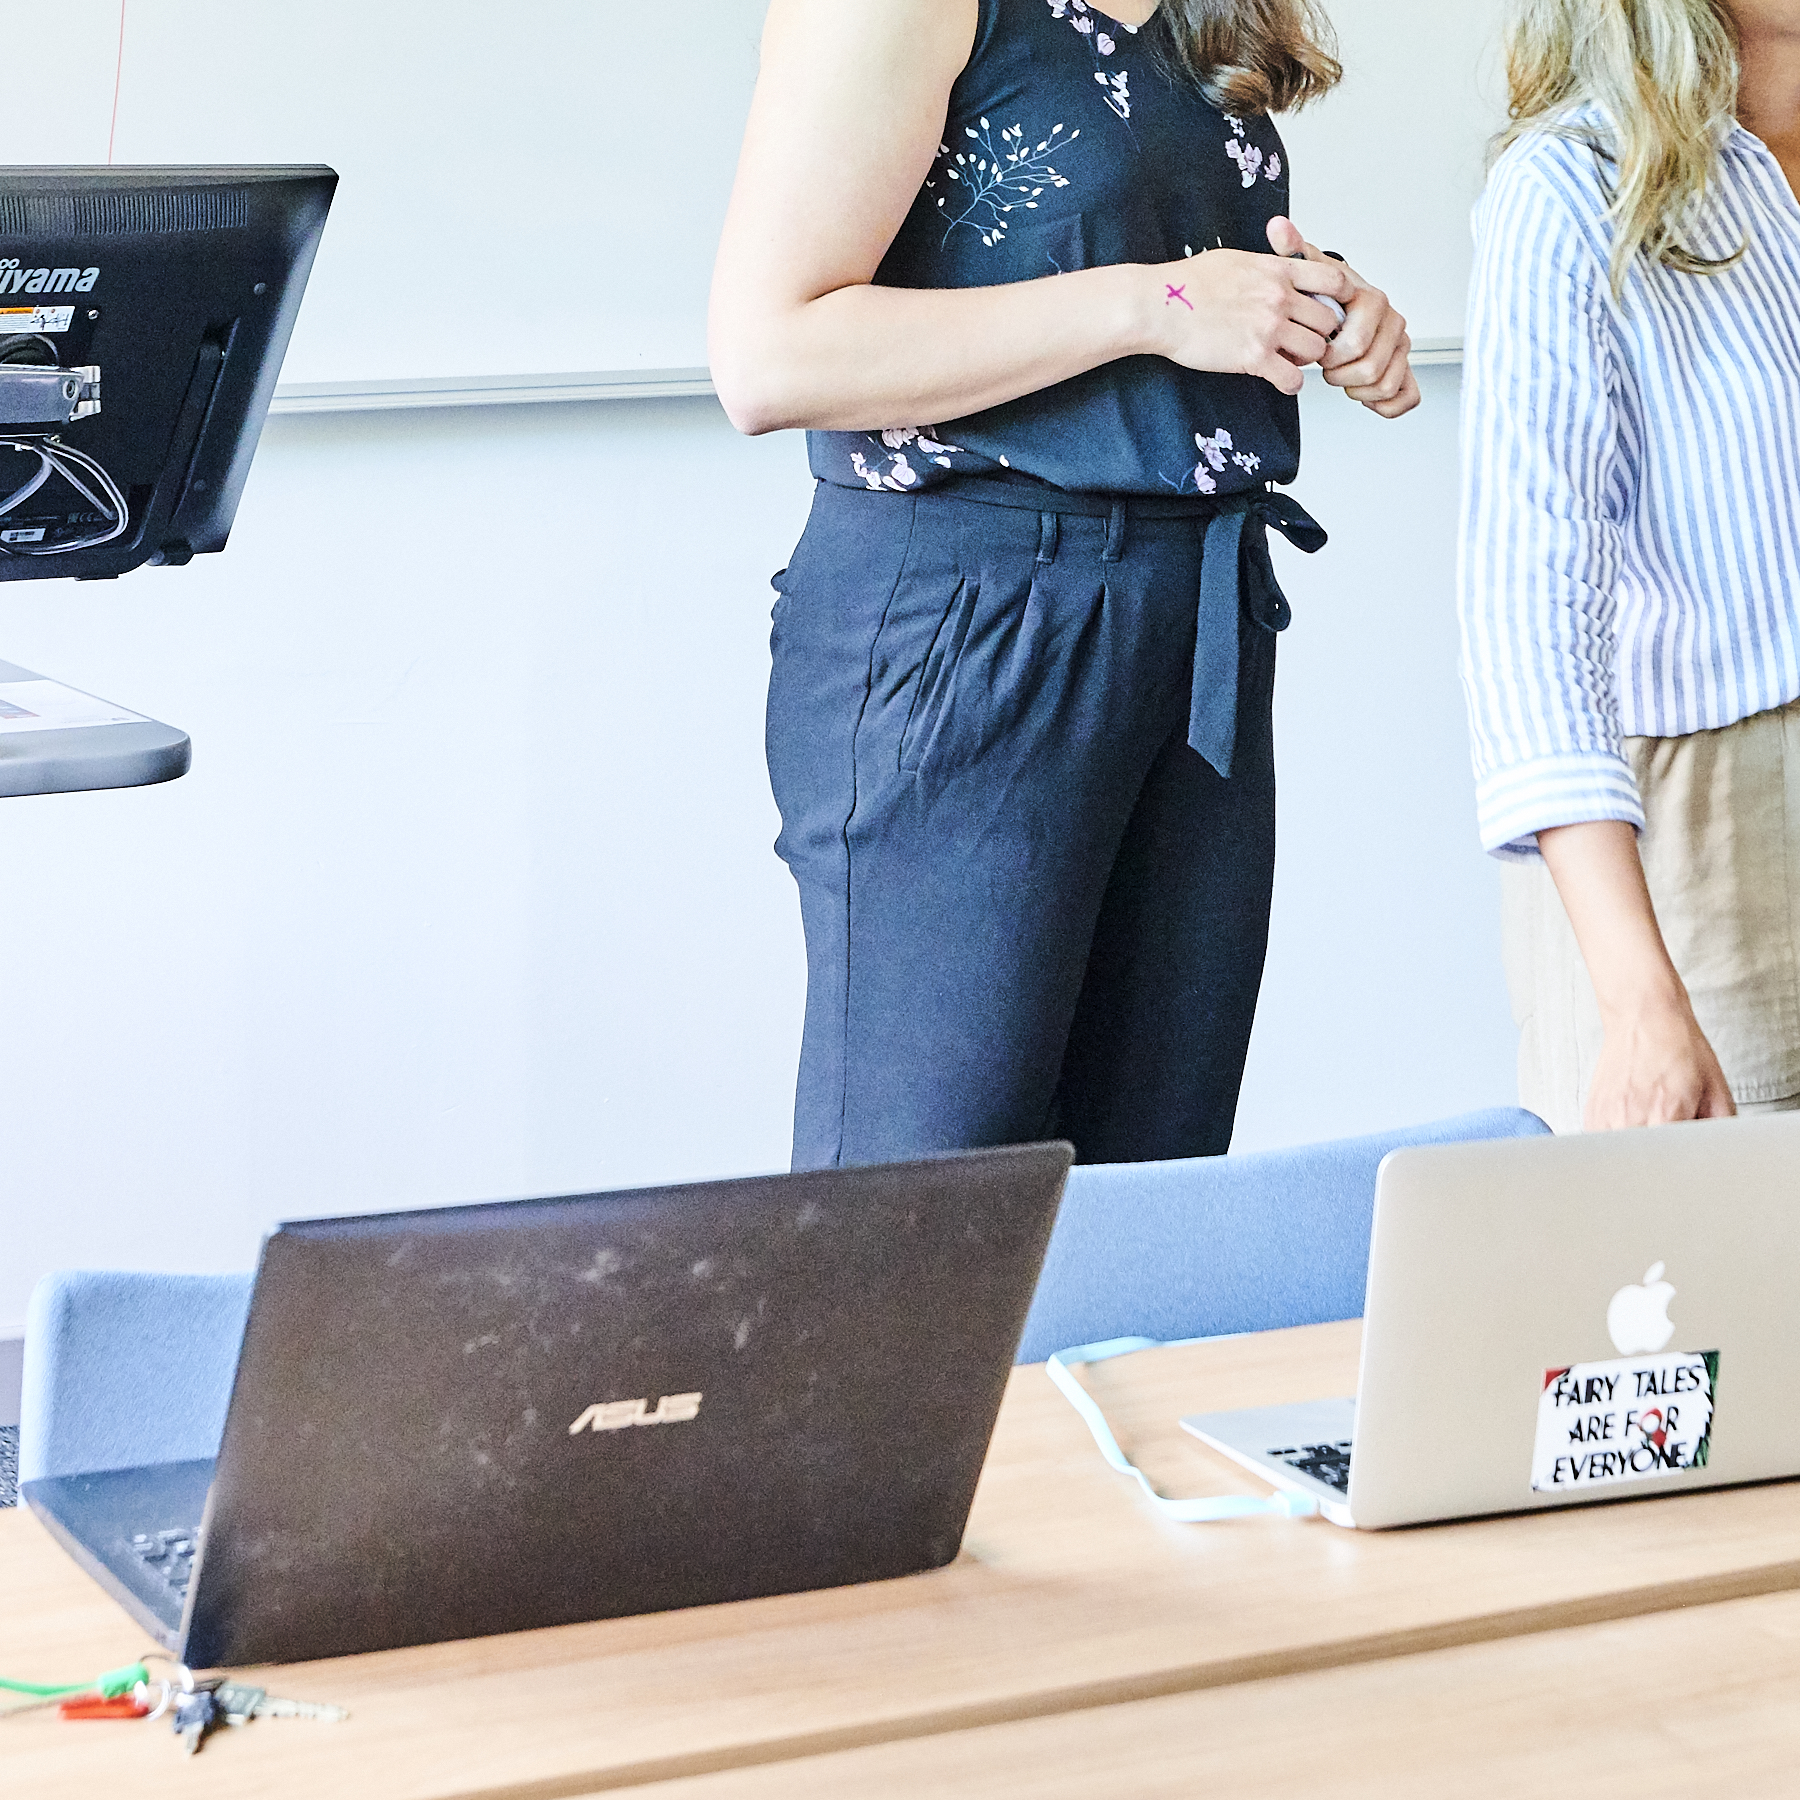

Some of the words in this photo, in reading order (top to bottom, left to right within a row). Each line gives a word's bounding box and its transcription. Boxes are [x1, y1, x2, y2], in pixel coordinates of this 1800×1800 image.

[1554, 1372, 1620, 1407] FAIRY
[1633, 1365, 1707, 1397] TALES
[568, 1392, 703, 1435] ASUS
[1569, 1413, 1615, 1443] ARE
[1625, 1406, 1679, 1437] FOR
